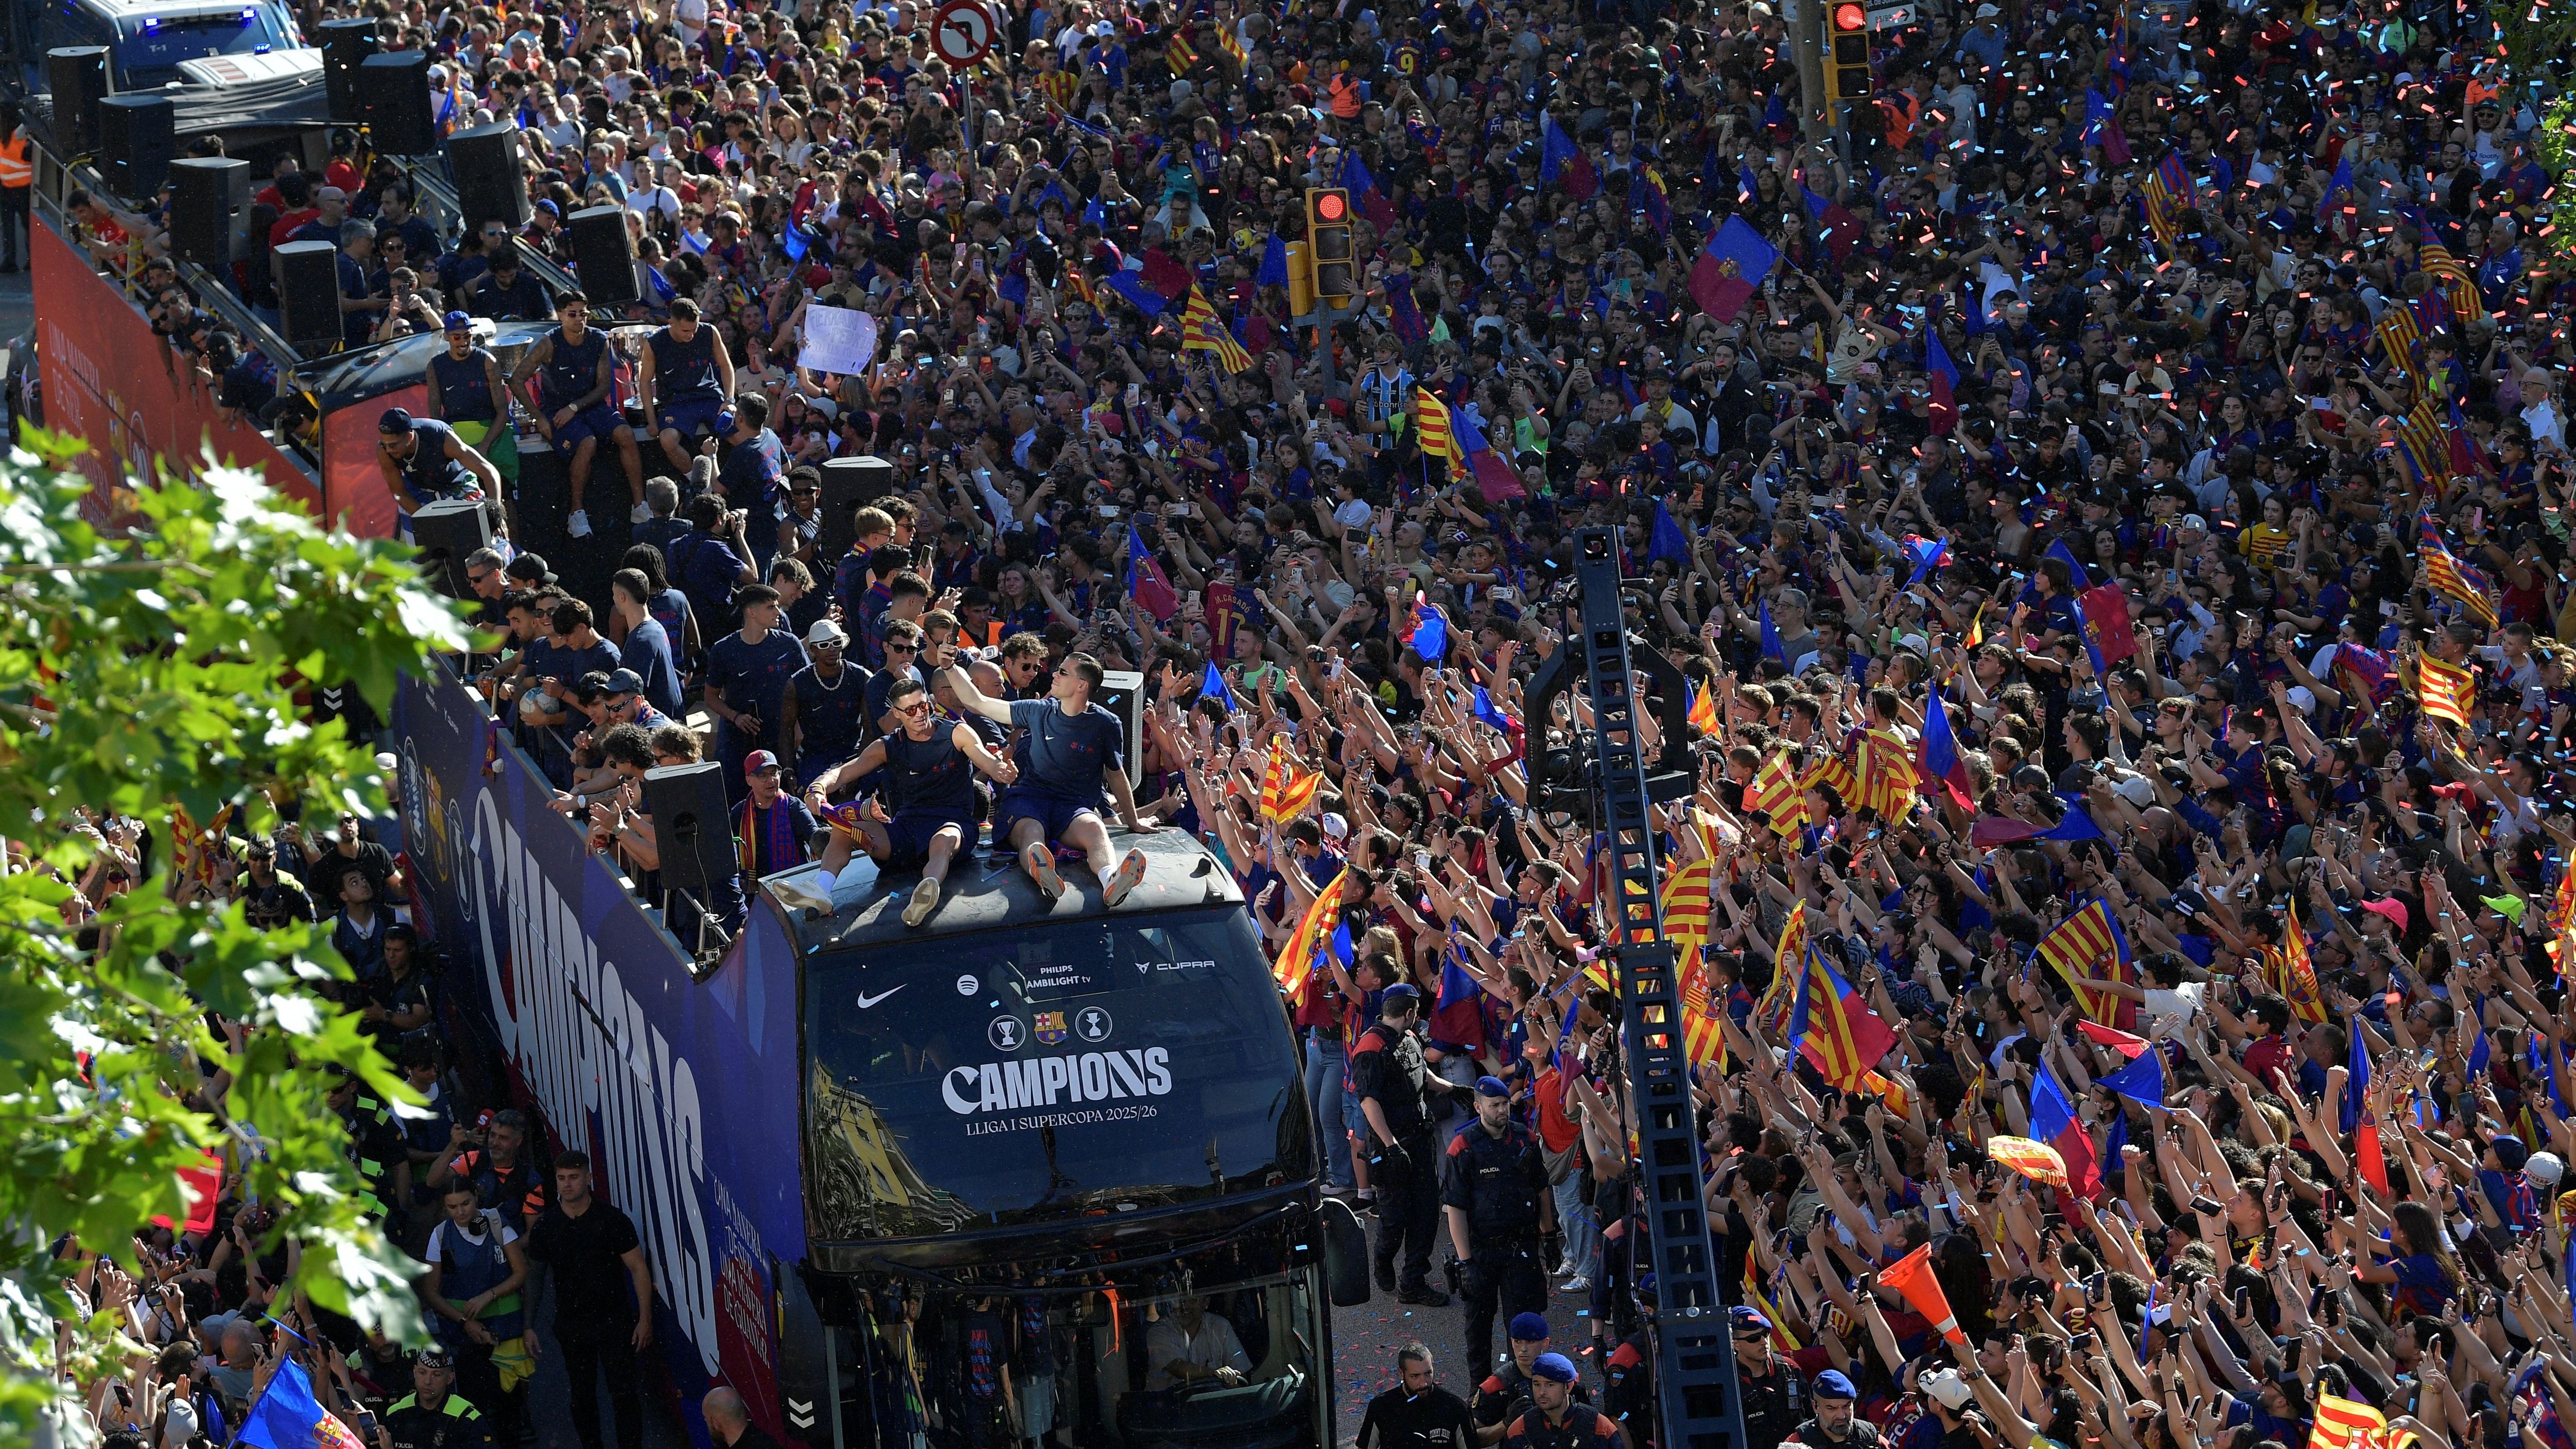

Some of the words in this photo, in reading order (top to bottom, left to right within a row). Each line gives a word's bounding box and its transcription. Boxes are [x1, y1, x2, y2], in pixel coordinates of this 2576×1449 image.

[1401, 54, 1413, 74] 9
[1881, 96, 1895, 104] PEDRI
[1207, 154, 1218, 167] 10
[809, 307, 859, 330] FERRAN
[1215, 594, 1251, 614] M.CASADÓ
[1217, 607, 1246, 646] 17
[1040, 965, 1073, 975] PHILIPS
[1156, 960, 1215, 971] CUPRA
[1026, 975, 1079, 989] AMBILIGHT
[1081, 975, 1091, 983] tv
[471, 787, 719, 1377] CAMPIONS
[942, 1046, 1172, 1114] CAMPIONS
[966, 1120, 1008, 1137] LLIGA
[1011, 1119, 1018, 1131] I
[1019, 1110, 1104, 1130] SUPERCOPA
[1105, 1104, 1158, 1122] 2025/26
[1748, 1410, 1765, 1419] POLICIA
[324, 1427, 337, 1436] FCB
